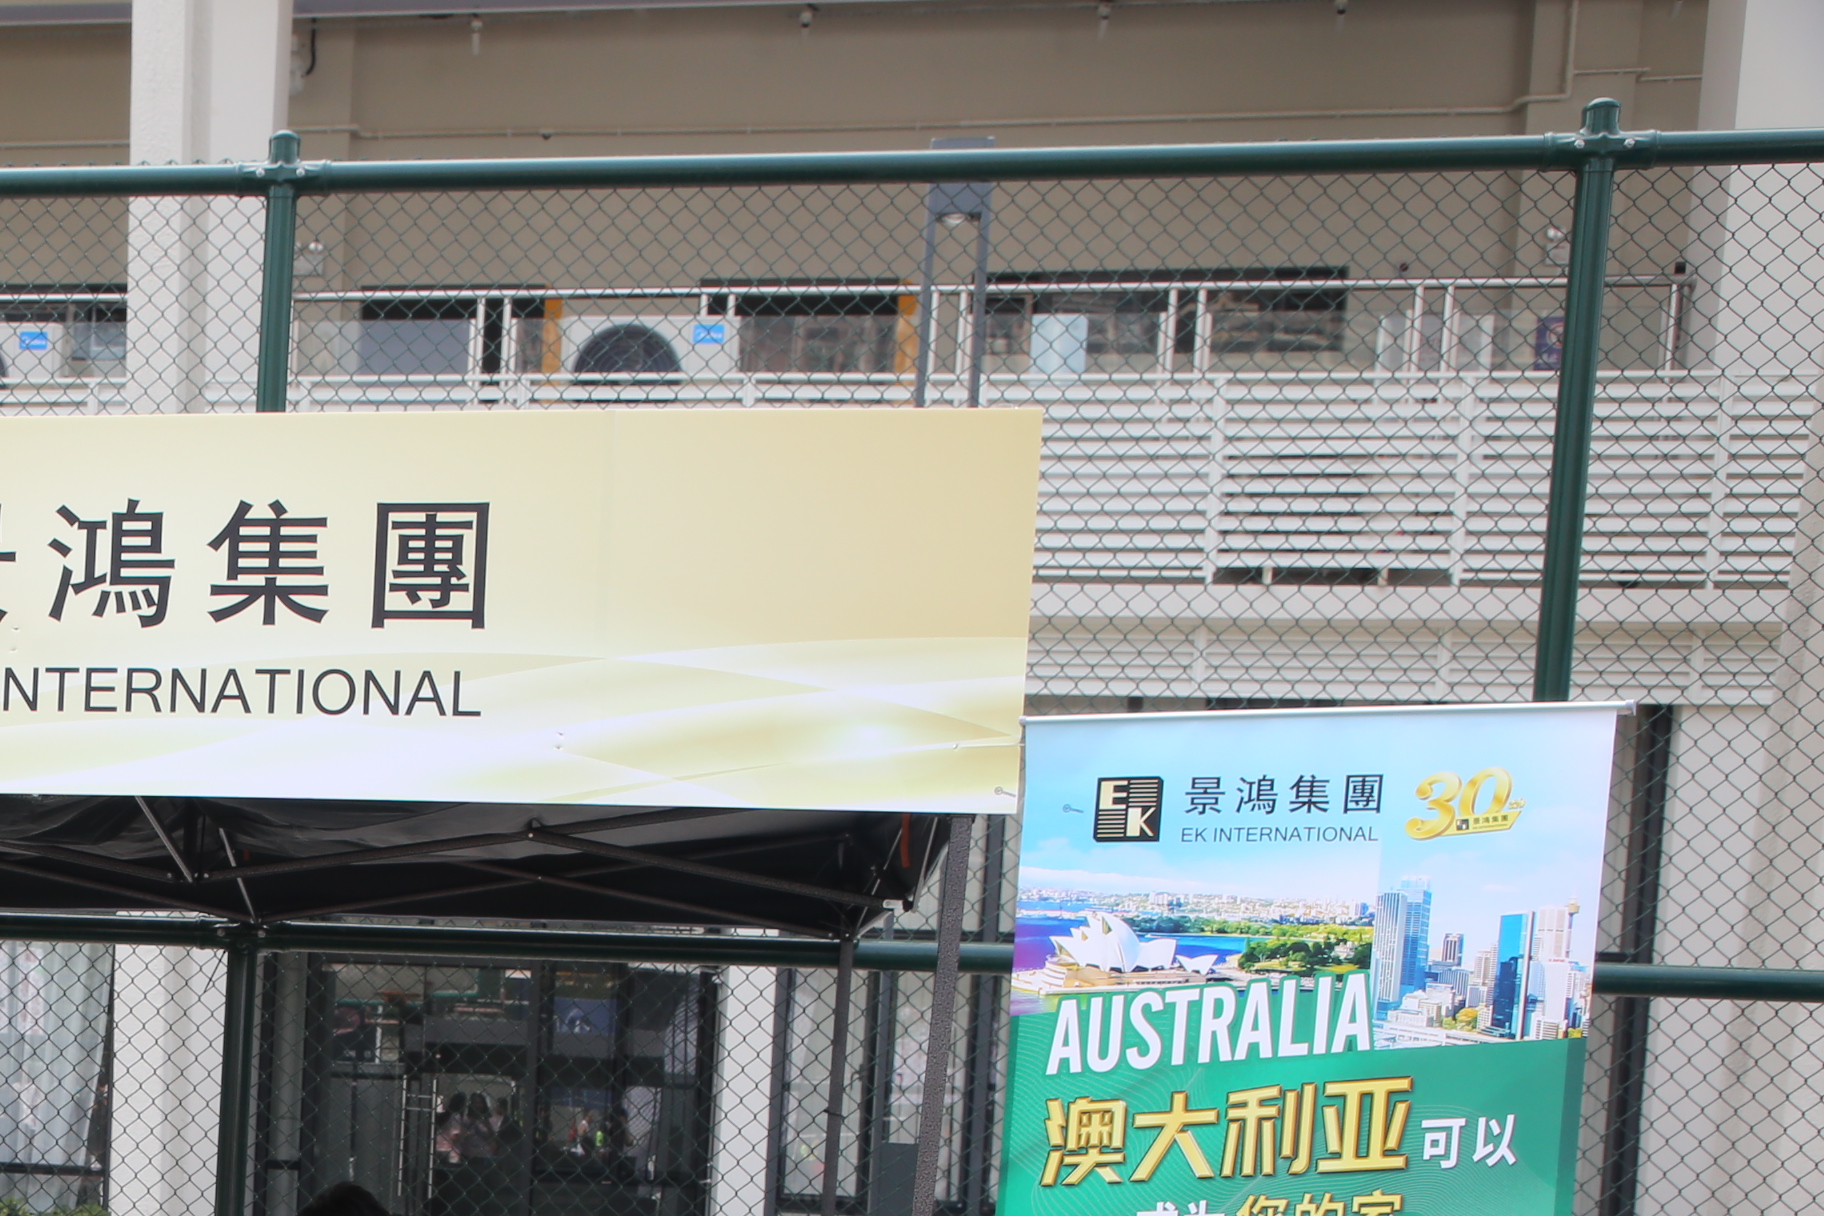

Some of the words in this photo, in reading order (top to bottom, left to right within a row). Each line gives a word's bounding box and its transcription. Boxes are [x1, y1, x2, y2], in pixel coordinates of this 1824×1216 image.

[1184, 773, 1384, 815] 景鴻集團
[1405, 767, 1512, 841] 30
[1181, 827, 1208, 843] EK
[1213, 826, 1379, 843] INTERNATIONAL
[1045, 973, 1372, 1075] AUSTRALIA
[1039, 1076, 1414, 1187] 澳大利亚
[1420, 1114, 1518, 1169] 可以
